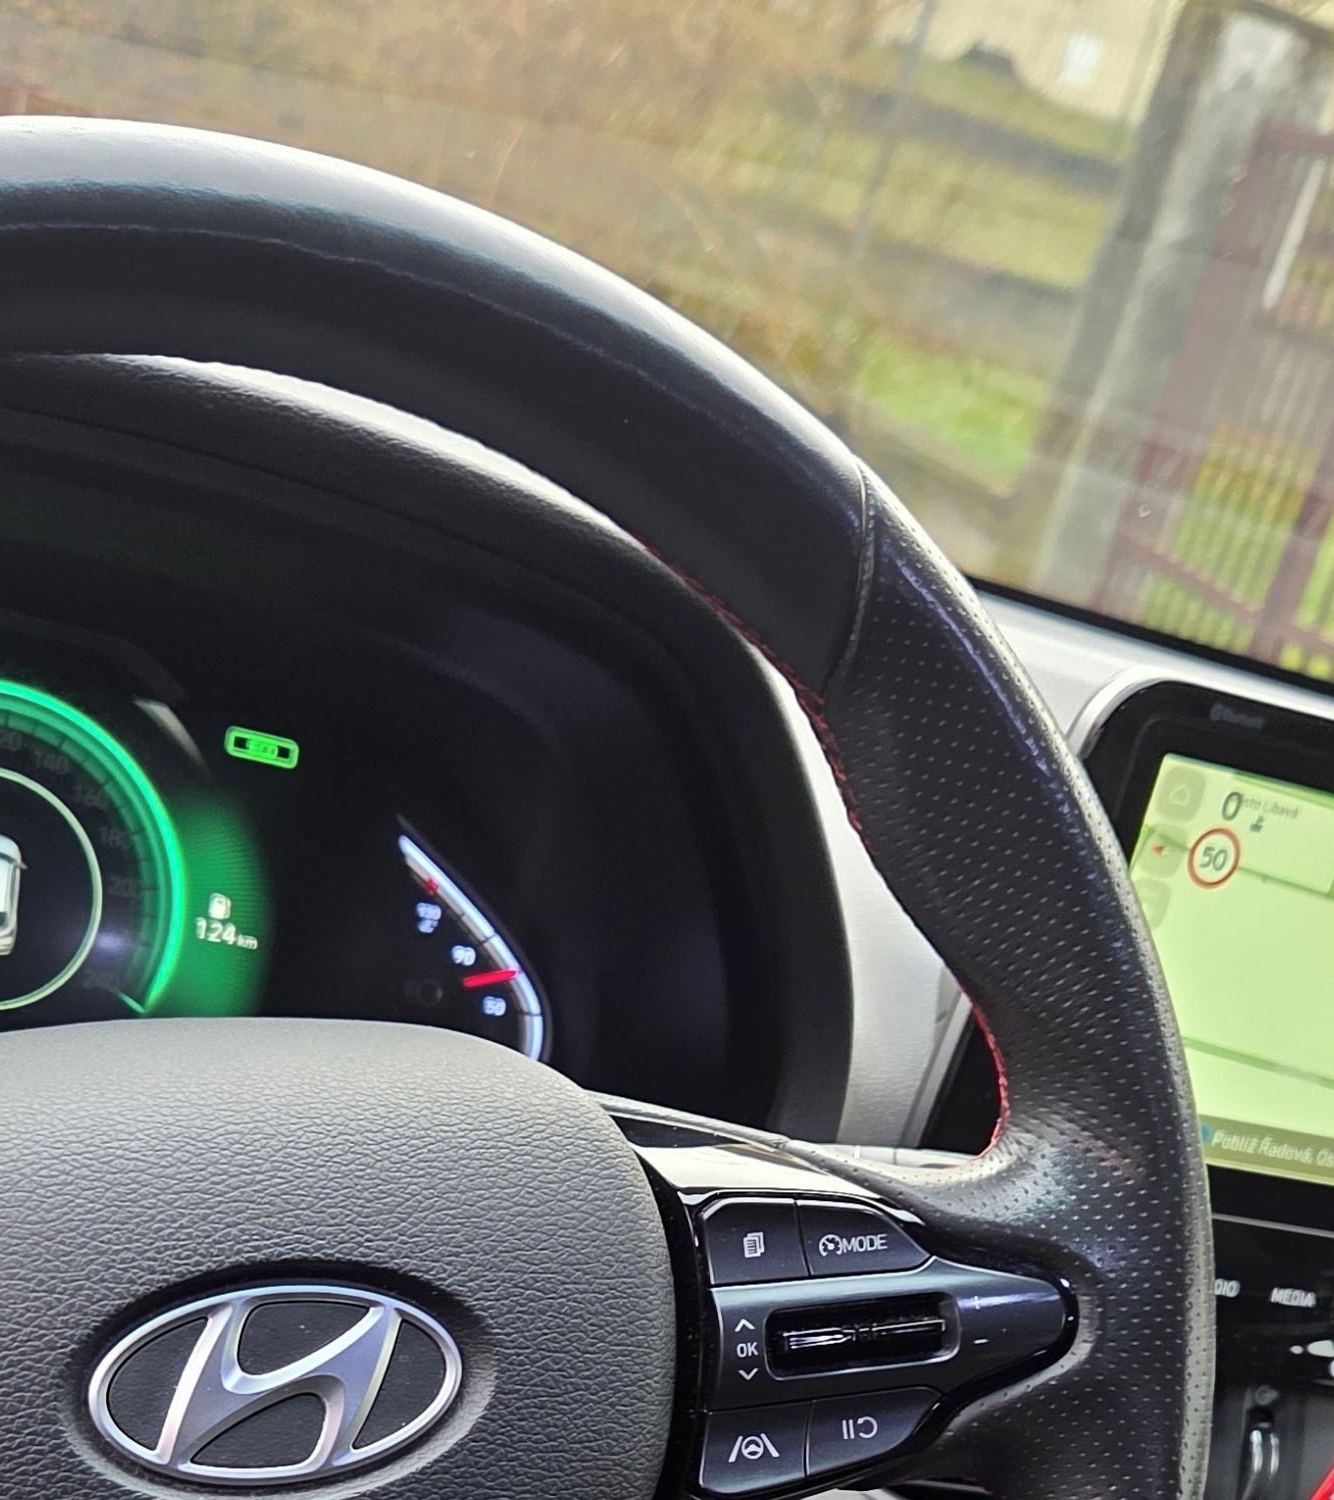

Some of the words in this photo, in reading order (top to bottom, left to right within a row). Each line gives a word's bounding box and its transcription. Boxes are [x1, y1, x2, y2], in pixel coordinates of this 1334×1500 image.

[1199, 846, 1228, 872] 50
[195, 916, 236, 945] 124
[452, 945, 476, 966] 90
[842, 1233, 888, 1253] MODE
[1214, 1278, 1241, 1298] DIO
[1271, 1287, 1316, 1308] MEDIA
[736, 1341, 759, 1358] OK
